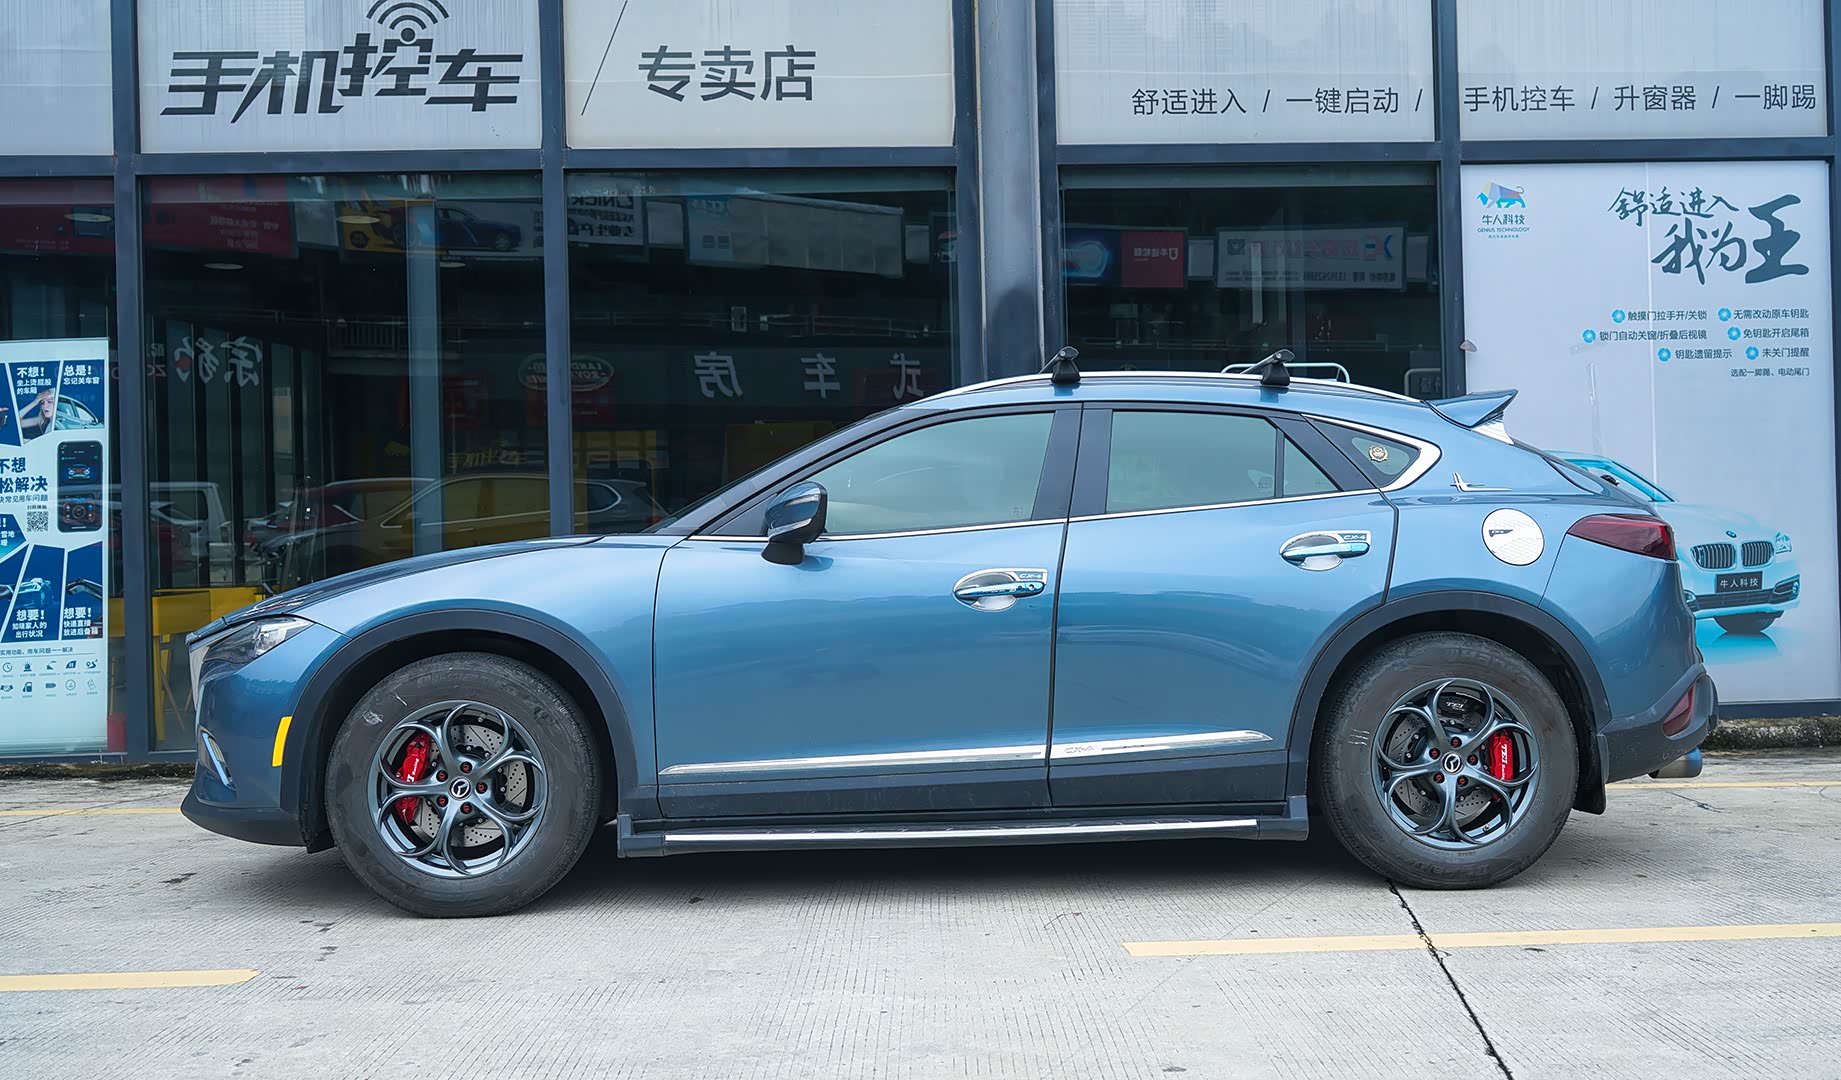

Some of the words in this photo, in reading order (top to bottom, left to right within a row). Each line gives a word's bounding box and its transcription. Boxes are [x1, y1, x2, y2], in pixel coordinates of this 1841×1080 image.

[160, 33, 523, 123] 手机控车
[638, 45, 817, 102] 专卖店
[1131, 88, 1247, 116] 舒适进入
[1286, 86, 1400, 114] 一键启动
[1463, 84, 1576, 112] 手机控车
[1613, 84, 1698, 112] 升窗器
[1734, 83, 1817, 112] 一脚踢
[1607, 186, 1739, 227] 舒适进入
[1482, 214, 1525, 225] 牛人科技
[1651, 194, 1810, 285] 我为王
[1627, 310, 1708, 321] 触摸门拉手开/关锁
[1733, 309, 1810, 320] 无需改动原车钥匙
[1599, 330, 1708, 341] 锁门自动关窗/折叠后视镜
[1743, 327, 1810, 339] 免钥匙开启尾箱
[1675, 348, 1733, 359] 钥匙遗留提示
[1761, 347, 1810, 358] 未关门提醒
[63, 377, 100, 385] 忘记关车窗
[1720, 578, 1759, 588] 牛人科技
[15, 630, 43, 639] 出行状况
